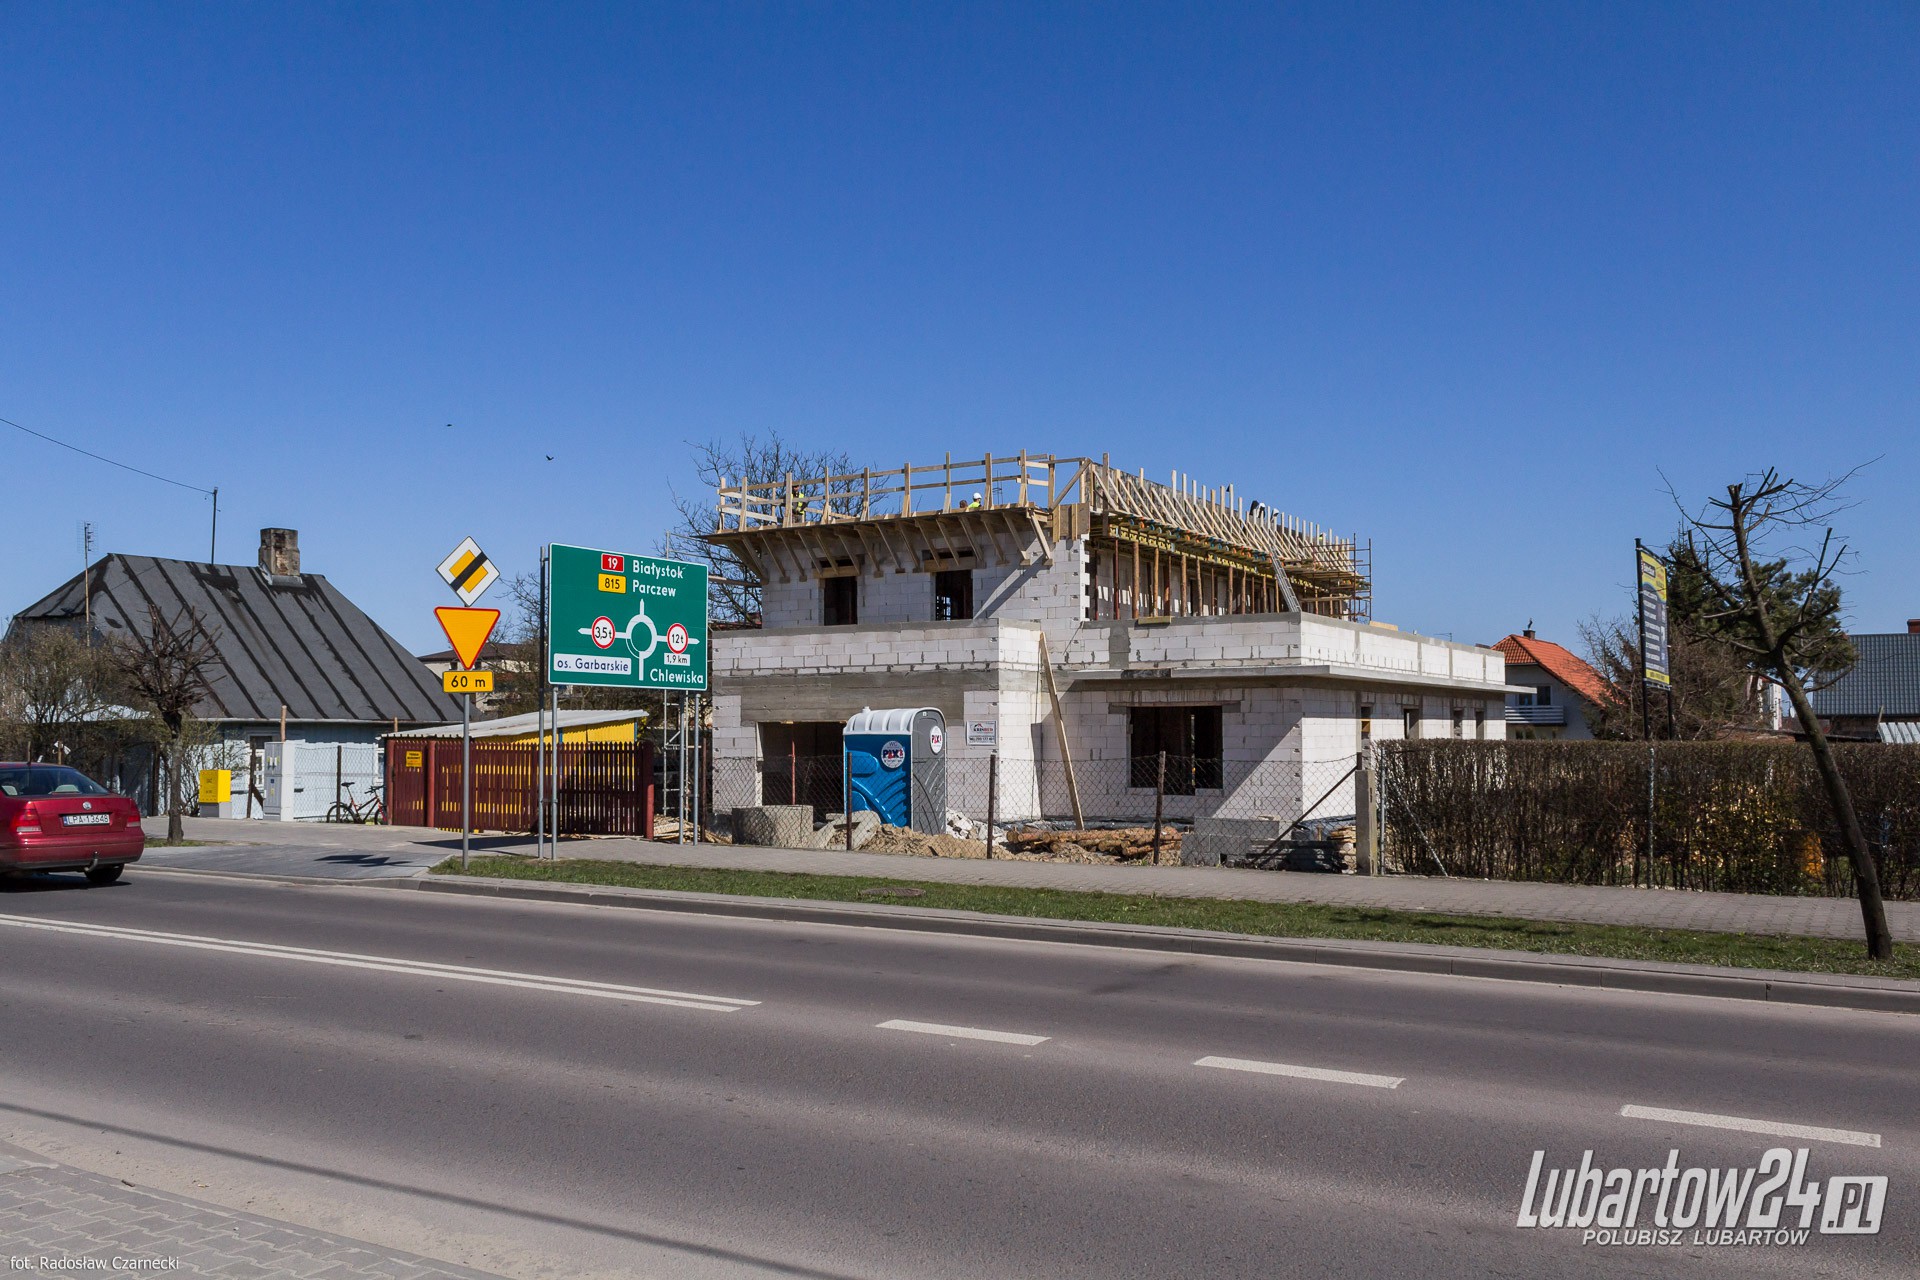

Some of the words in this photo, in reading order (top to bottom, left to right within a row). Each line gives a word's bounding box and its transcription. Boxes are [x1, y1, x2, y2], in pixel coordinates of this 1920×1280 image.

[607, 557, 619, 570] 19
[632, 559, 684, 580] Białystok
[604, 577, 621, 590] 815
[632, 579, 677, 597] Parczew
[557, 659, 572, 669] os.
[575, 658, 629, 672] Garbarskie
[450, 675, 468, 688] 60
[475, 678, 486, 688] m
[650, 668, 704, 684] Chlewiska
